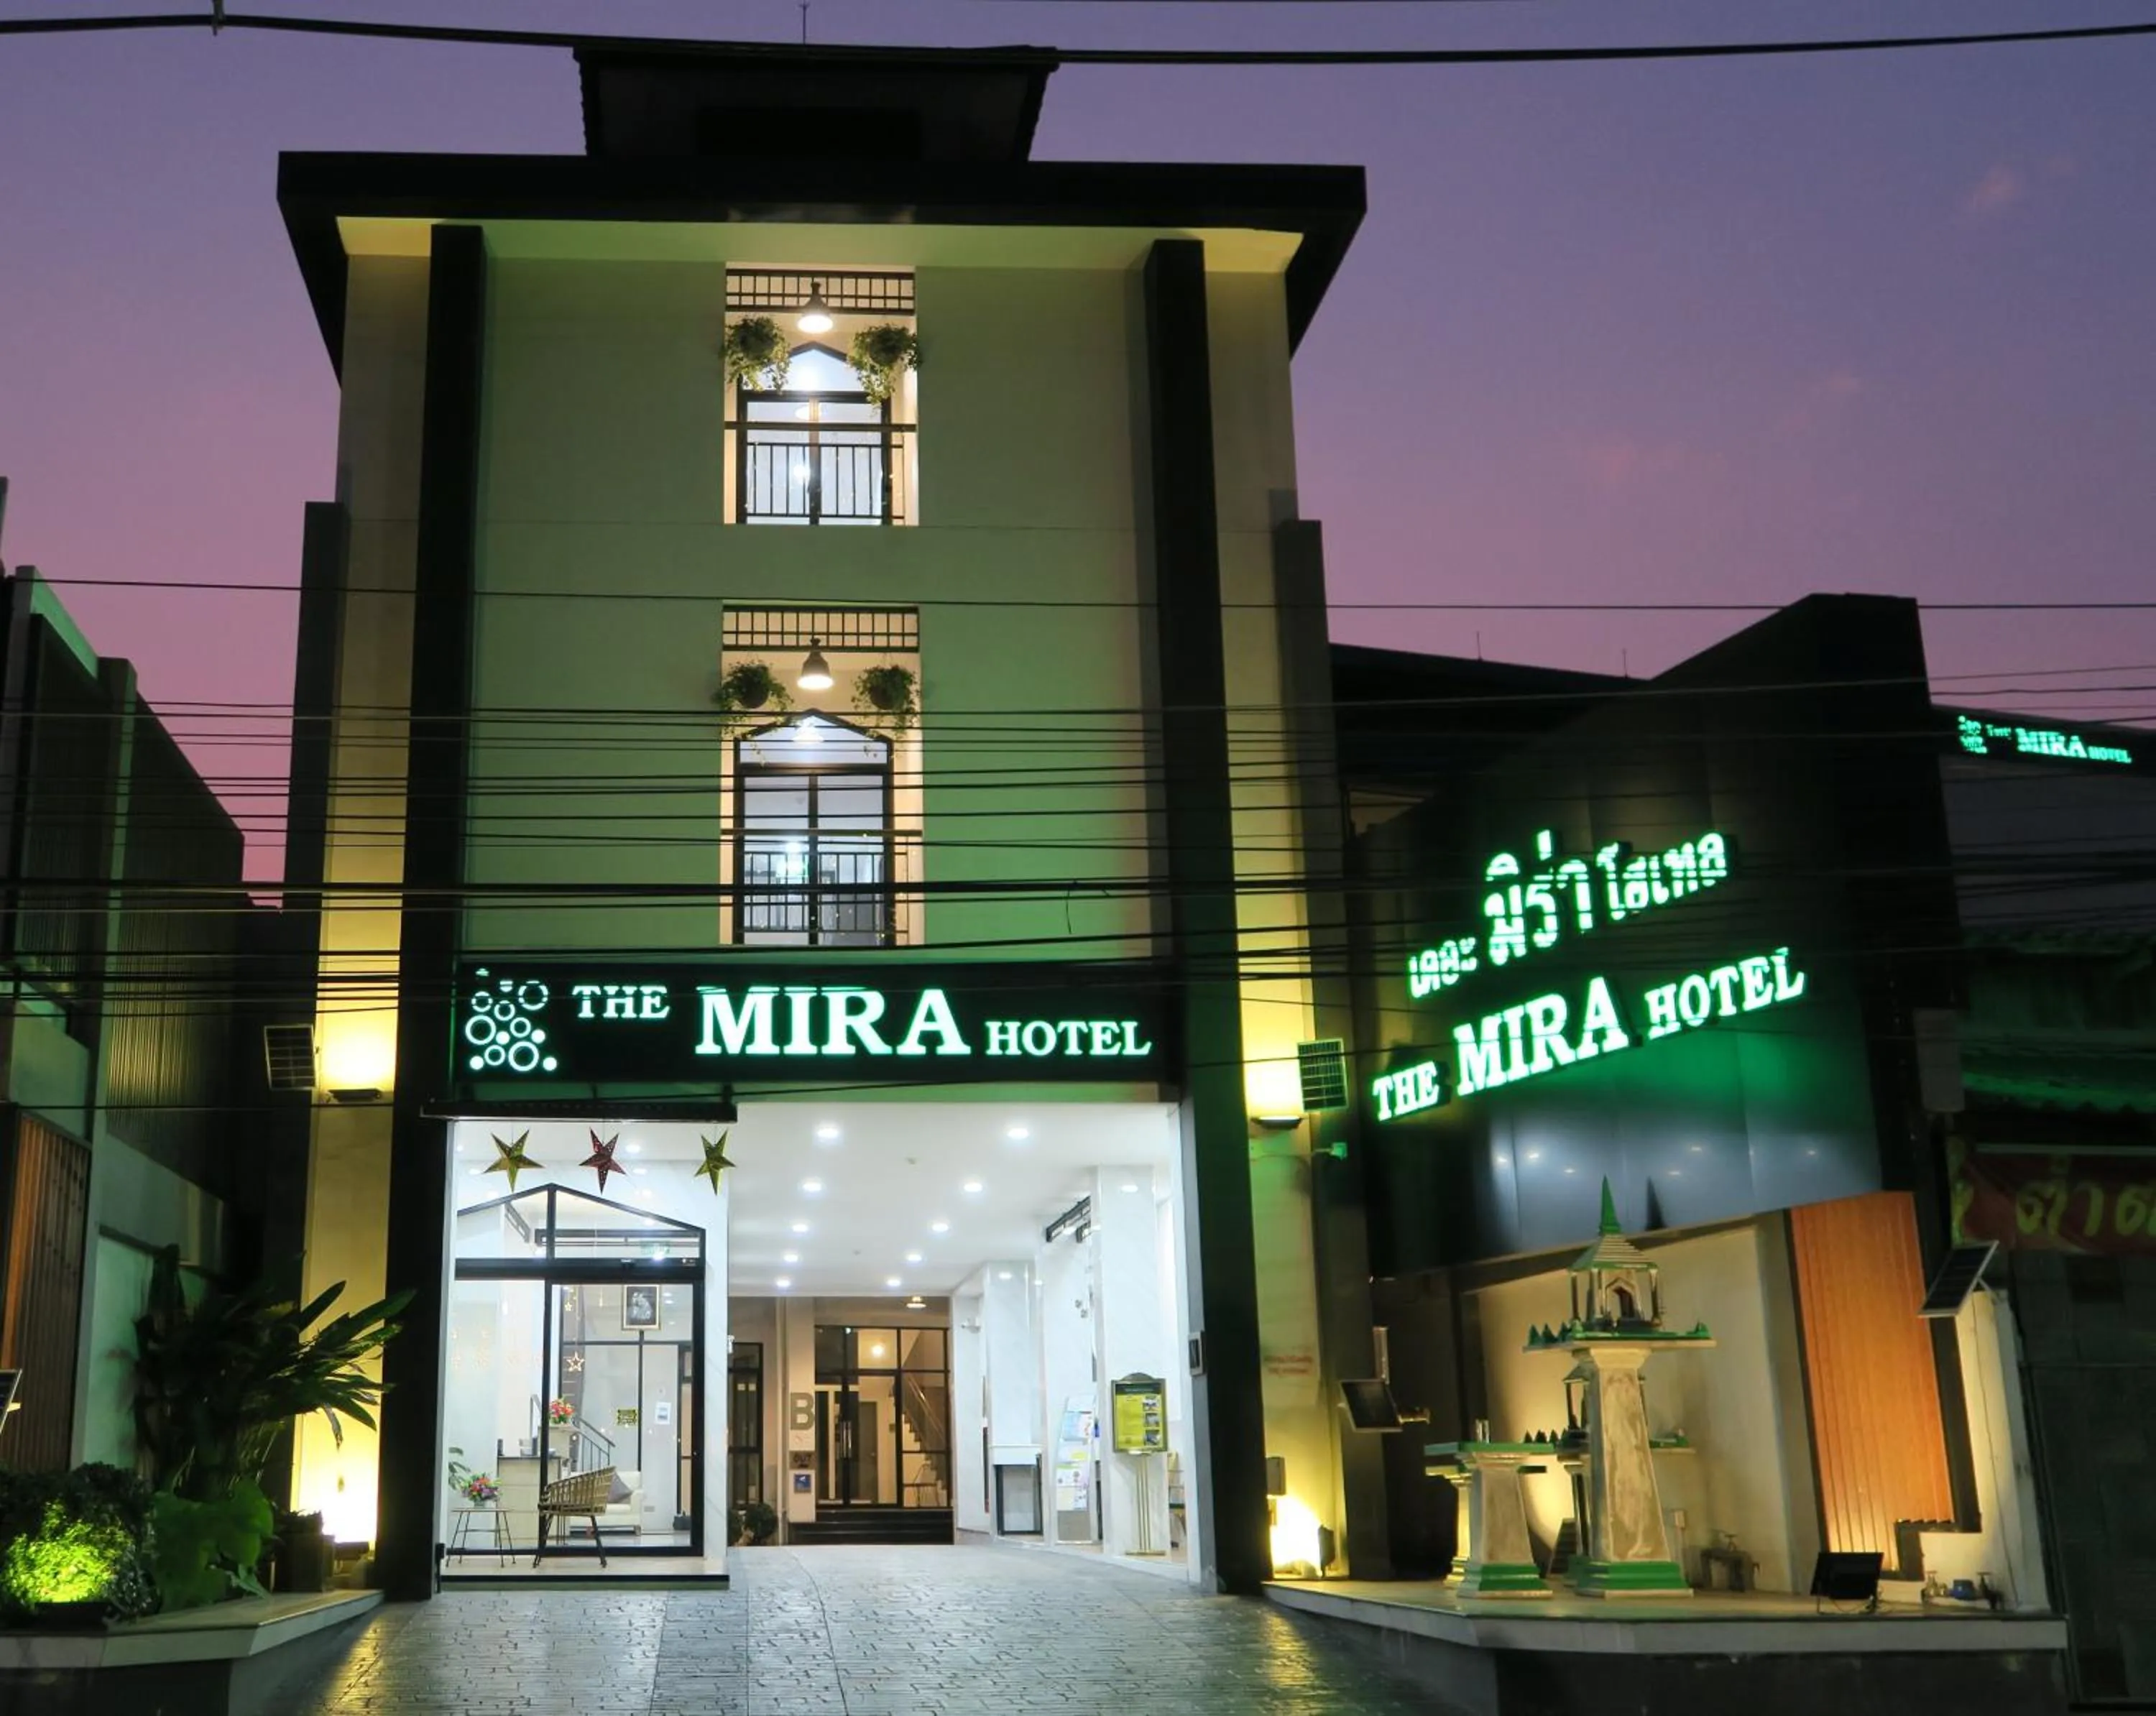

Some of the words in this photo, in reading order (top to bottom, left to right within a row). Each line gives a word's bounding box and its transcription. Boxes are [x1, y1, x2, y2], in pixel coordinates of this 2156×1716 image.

[2015, 727, 2087, 758] MIRA
[571, 985, 671, 1018] THE
[695, 986, 972, 1055] MIRA
[985, 1020, 1152, 1056] HOTEL
[1372, 1061, 1439, 1122] THE
[1453, 977, 1629, 1096] MIRA
[1644, 947, 1805, 1041] HOTEL
[789, 1392, 815, 1430] B
